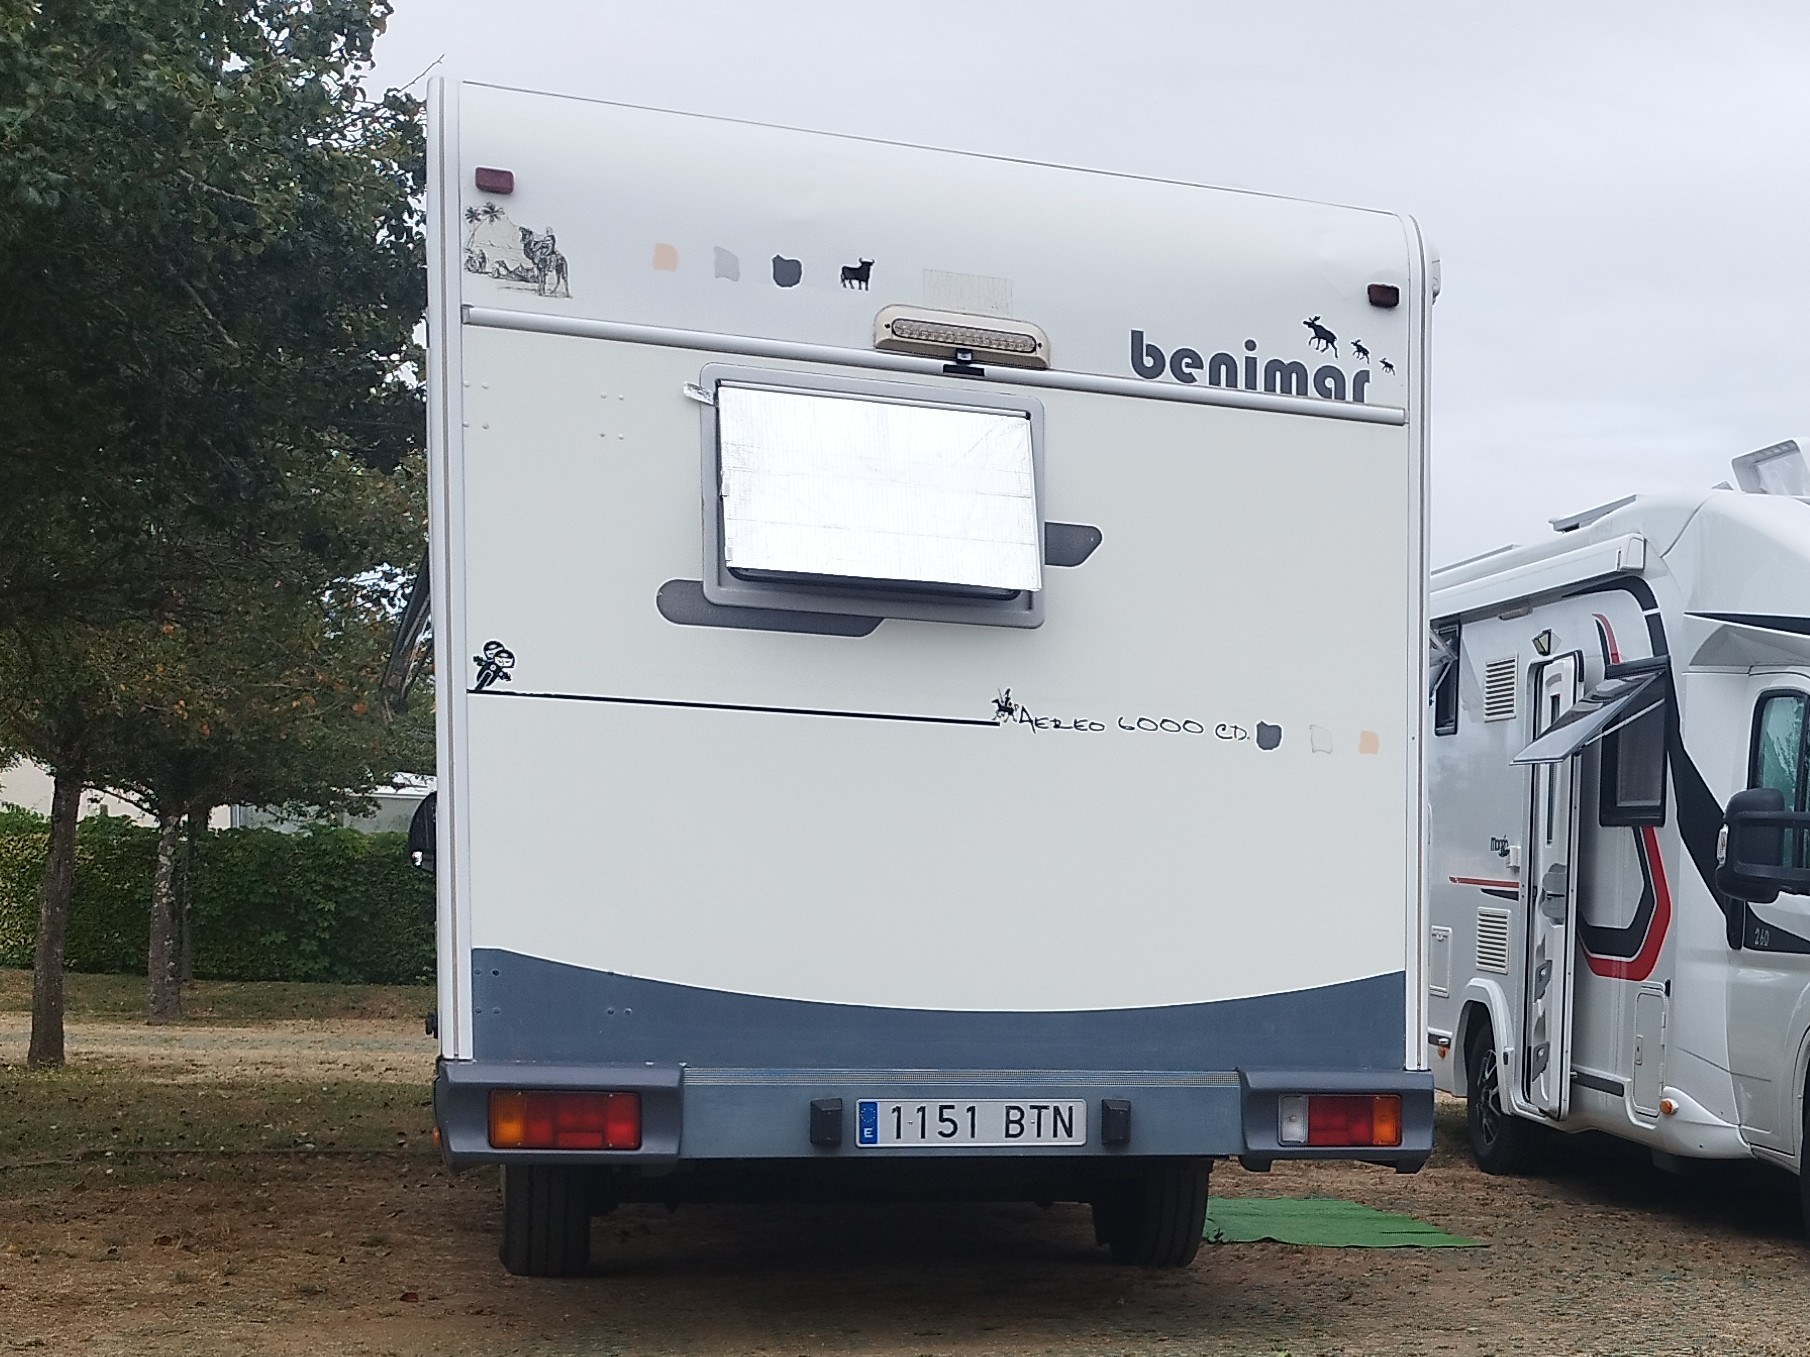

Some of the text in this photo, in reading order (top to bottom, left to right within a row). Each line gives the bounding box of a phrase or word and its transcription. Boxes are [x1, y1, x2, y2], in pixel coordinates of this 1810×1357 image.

[1131, 329, 1370, 402] benimar
[1019, 706, 1105, 734] AEREO
[1118, 716, 1204, 734] 6000
[863, 1127, 874, 1138] E
[891, 1104, 1074, 1140] 1151 BTN
